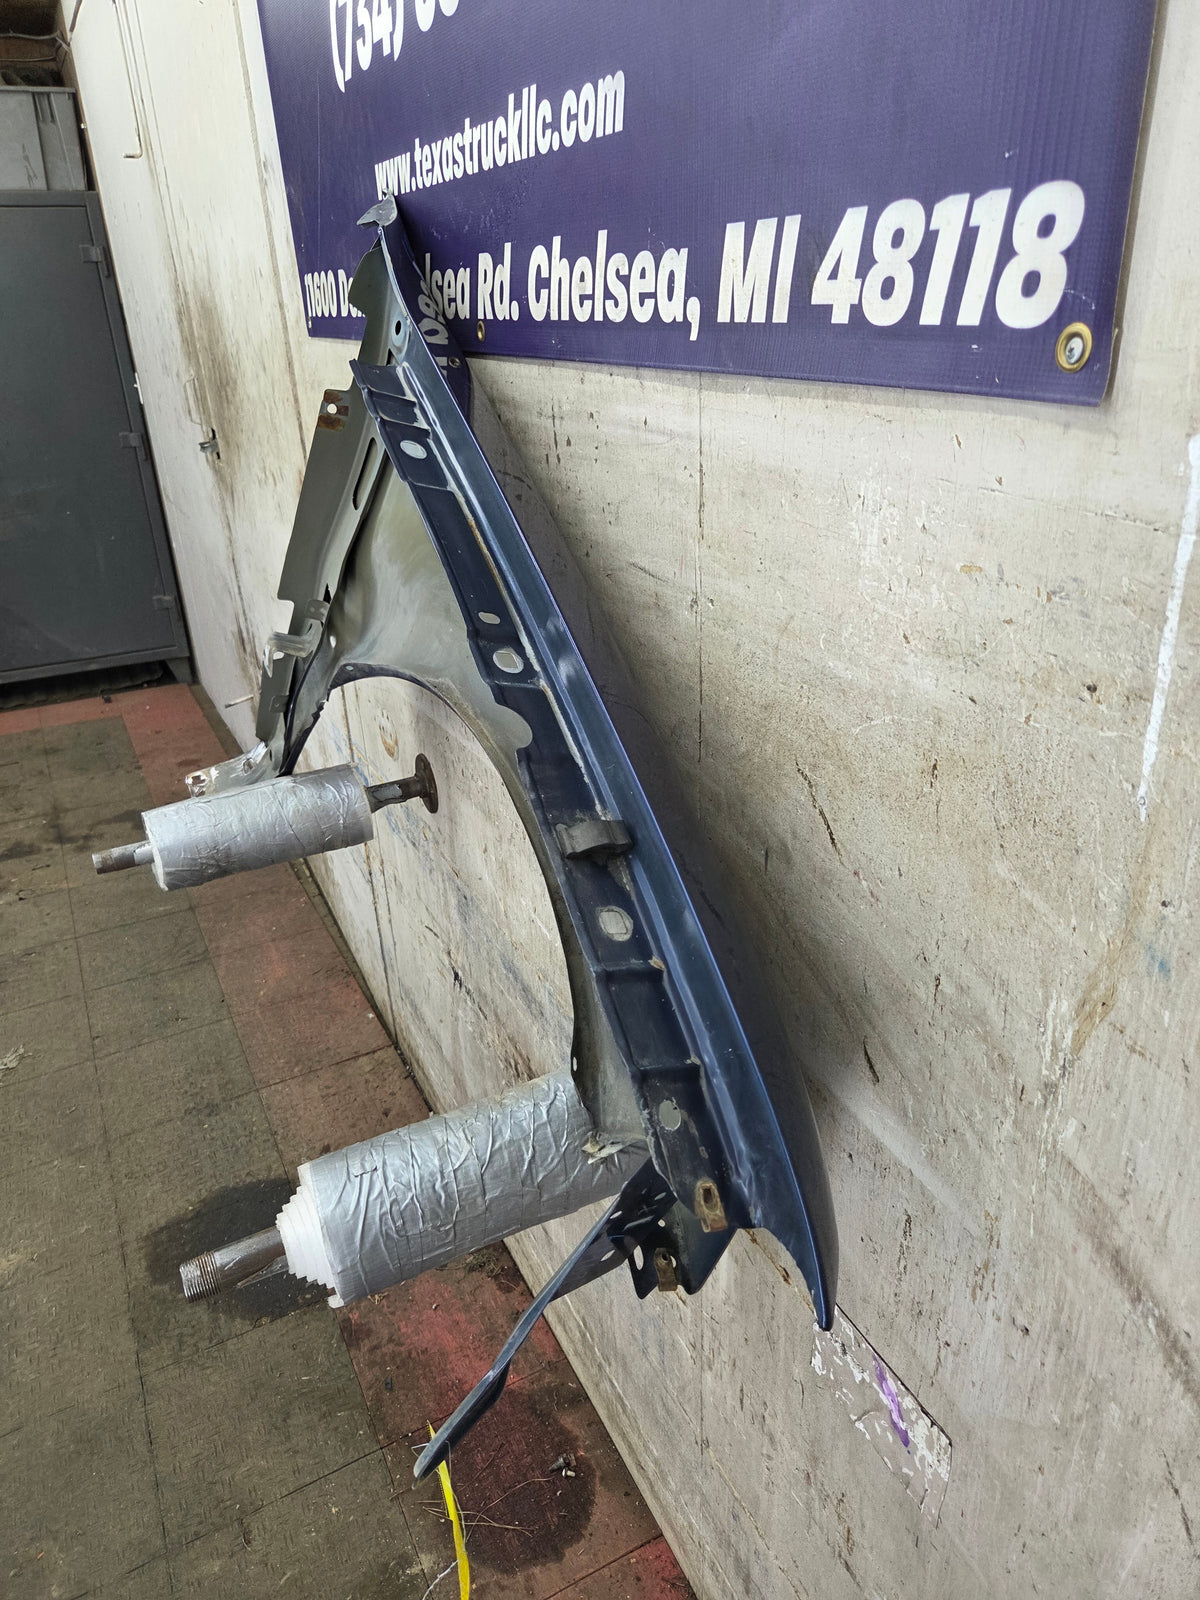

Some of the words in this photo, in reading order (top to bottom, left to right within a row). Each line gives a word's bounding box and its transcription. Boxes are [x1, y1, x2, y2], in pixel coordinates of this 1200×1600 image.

[374, 70, 625, 201] www.texastruckllc.com
[304, 269, 338, 318] 11600
[424, 252, 471, 320] lsea
[477, 242, 520, 321] Rd.
[527, 229, 701, 341] Chelsea,
[717, 214, 801, 324] MI
[811, 180, 1085, 330] 48118
